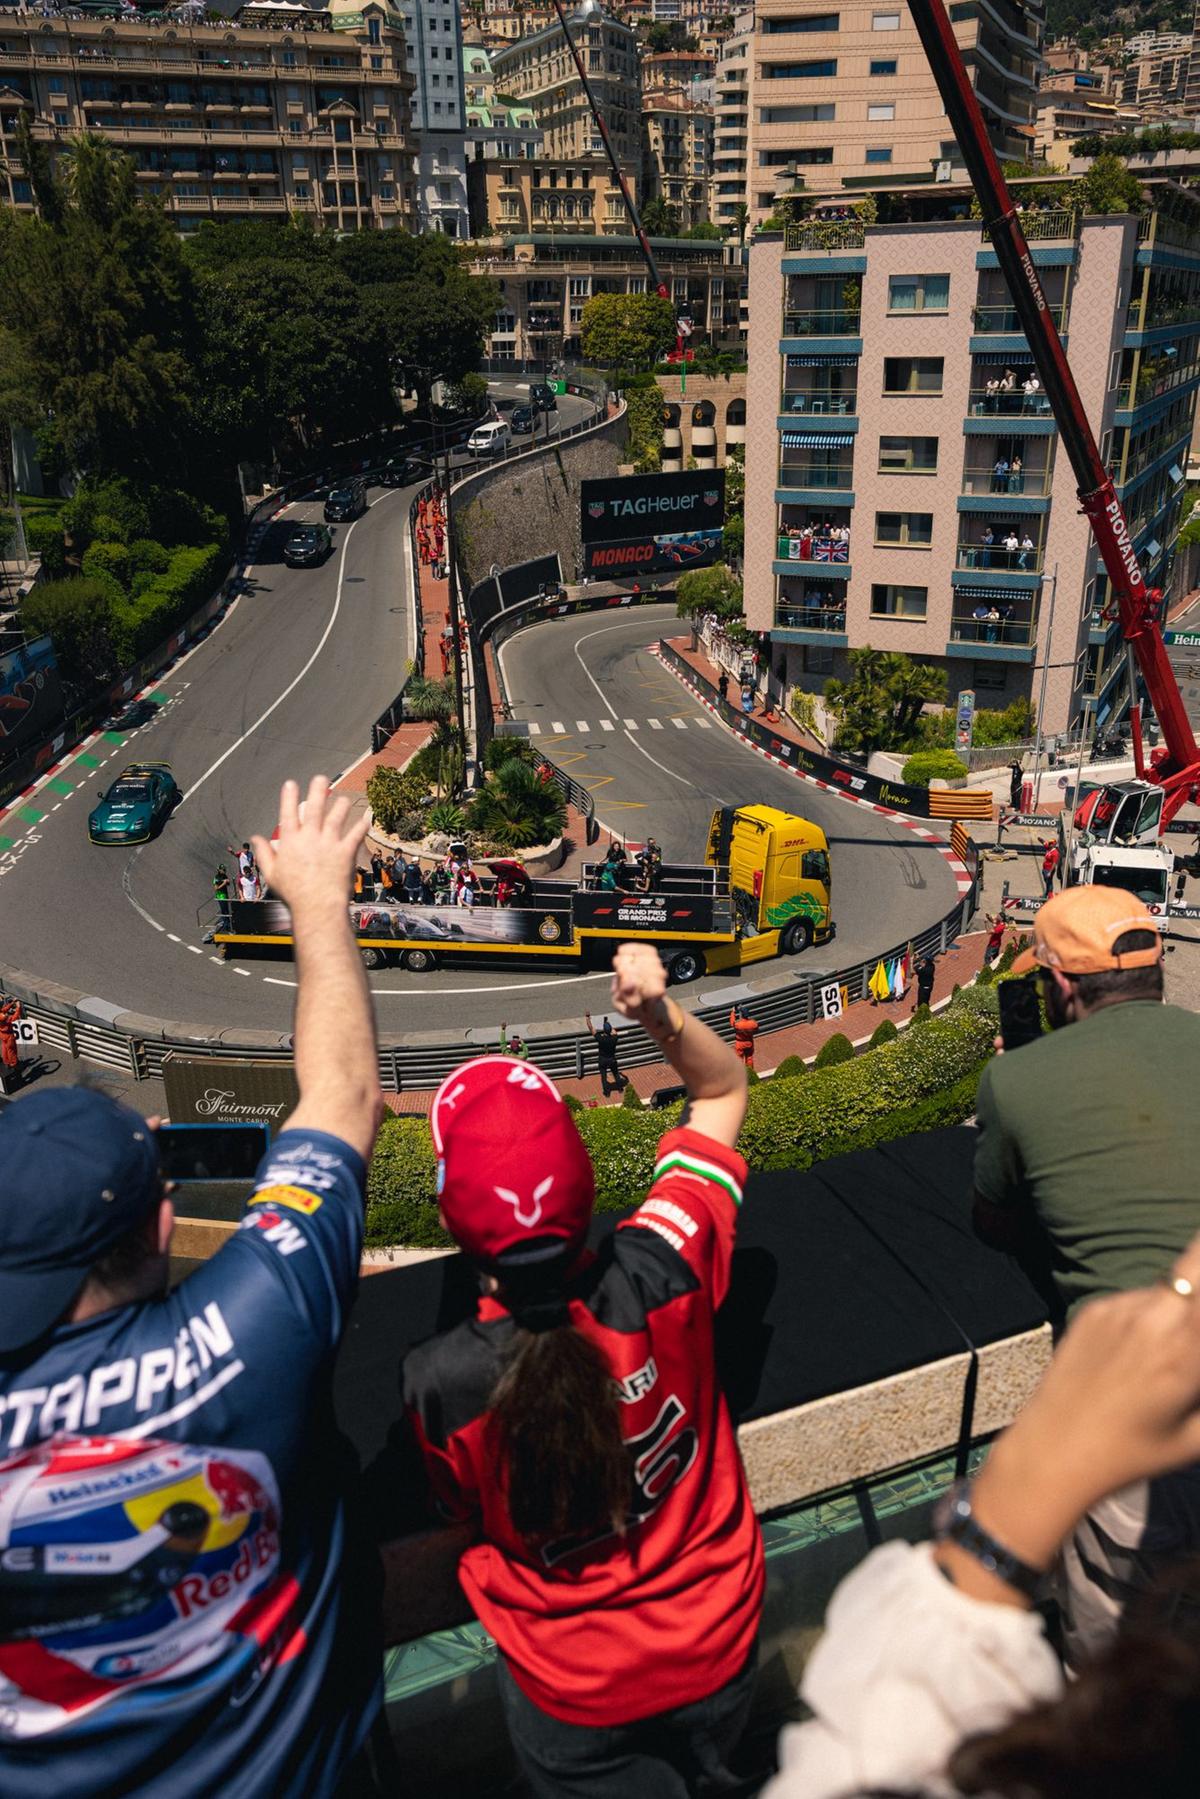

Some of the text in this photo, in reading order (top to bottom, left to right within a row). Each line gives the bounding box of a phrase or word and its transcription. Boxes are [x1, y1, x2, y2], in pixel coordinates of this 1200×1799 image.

[1020, 252, 1046, 311] PIOVANO
[592, 544, 654, 567] MONACO
[1106, 499, 1142, 586] PIOVANO
[879, 784, 911, 806] Monaco
[1019, 816, 1057, 826] PIOVANO
[781, 838, 809, 848] DHL
[617, 908, 647, 916] GRAND
[825, 987, 839, 1015] SC
[195, 1088, 288, 1118] Fairmont
[0, 1301, 234, 1448] TAPPEN
[174, 1541, 252, 1618] Red
